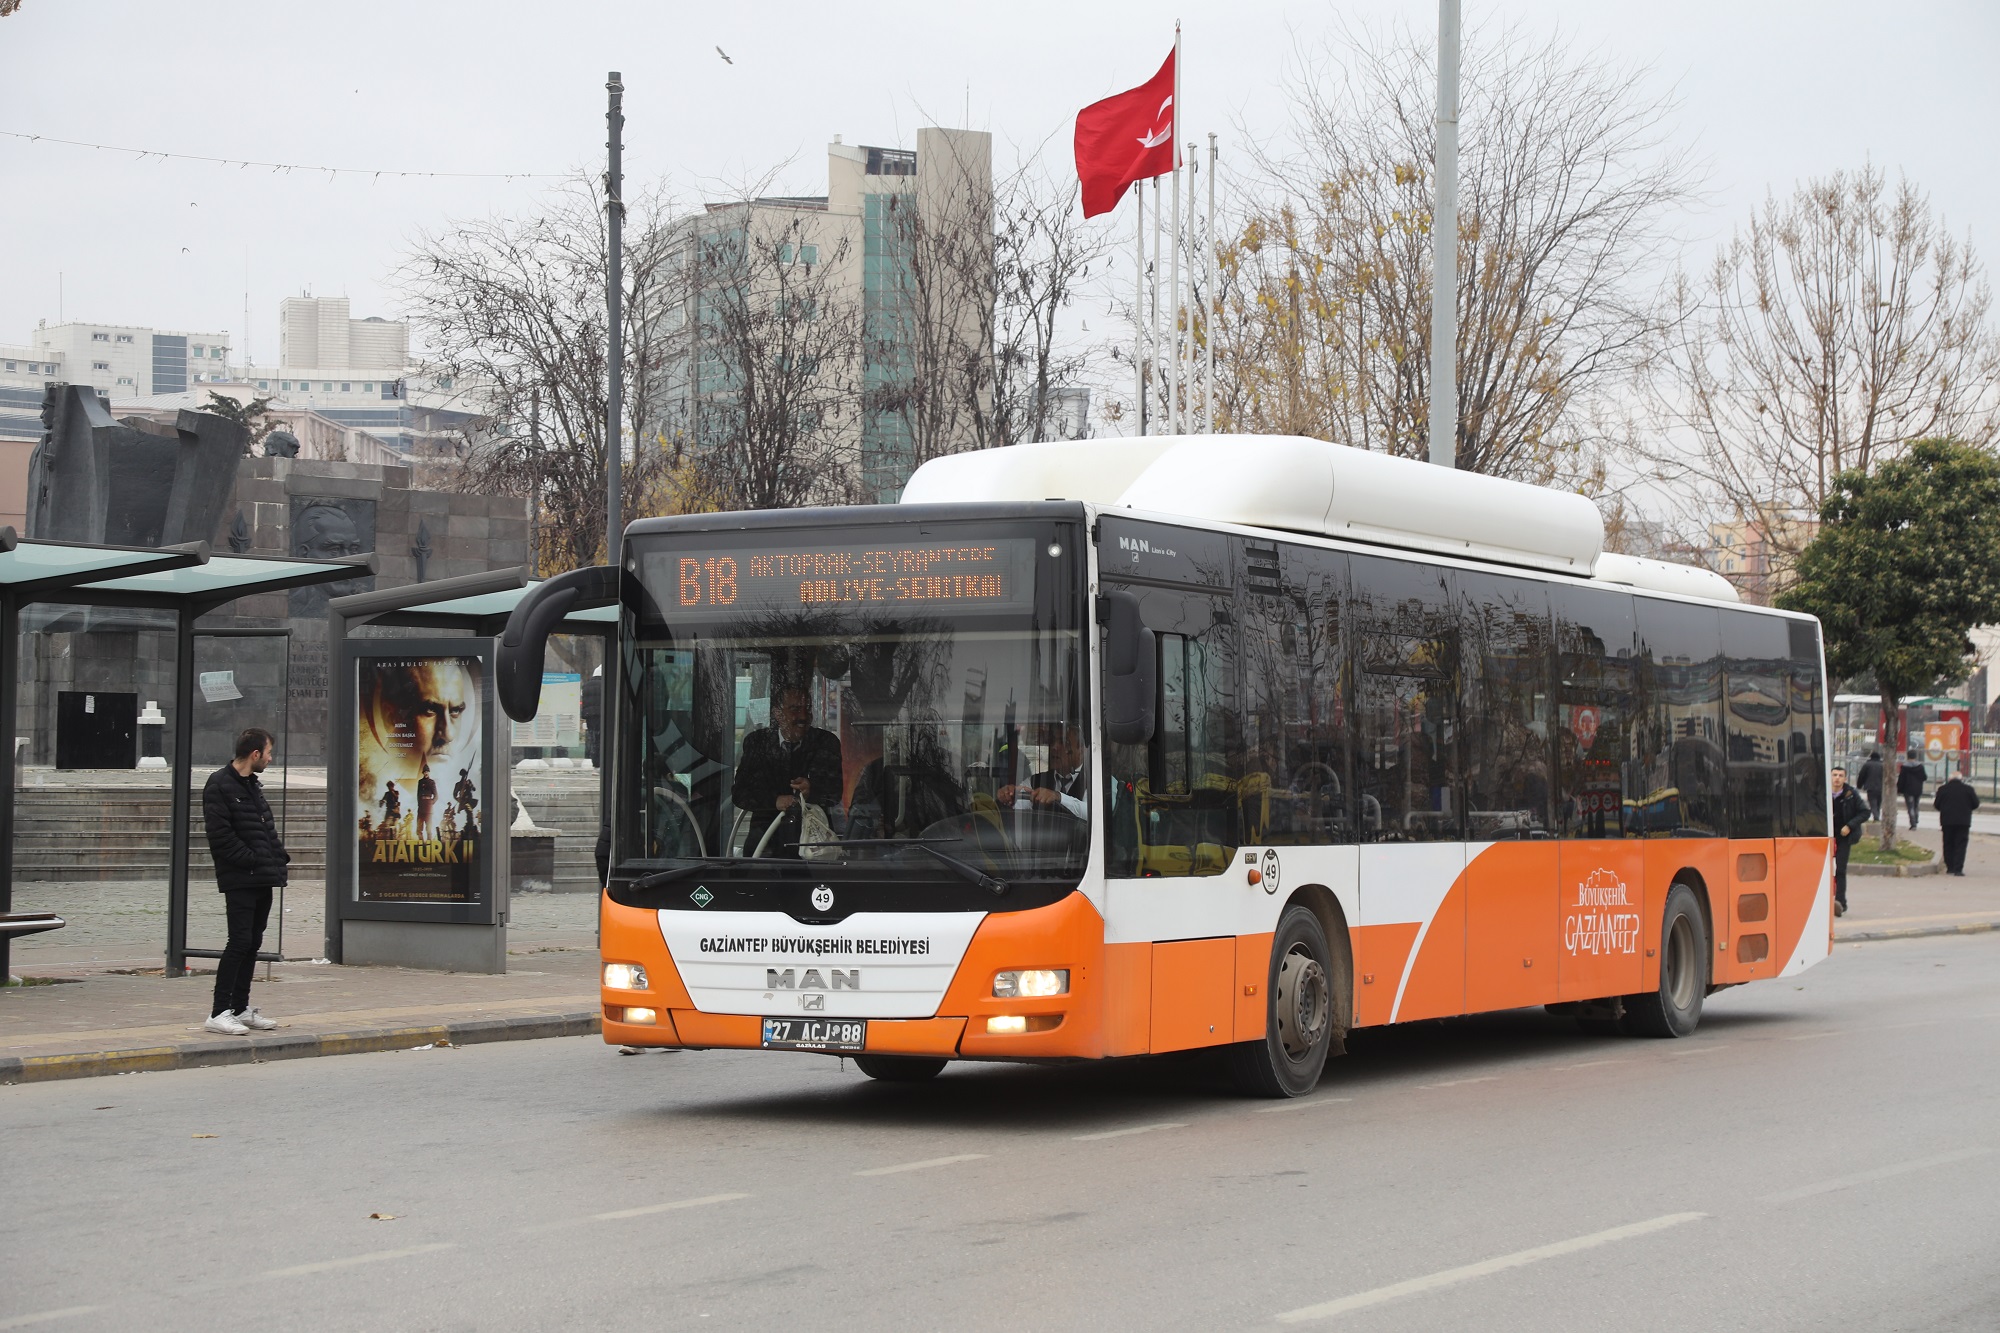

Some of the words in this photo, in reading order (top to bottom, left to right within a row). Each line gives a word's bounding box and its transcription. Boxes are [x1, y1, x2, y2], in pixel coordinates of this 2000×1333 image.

[1119, 536, 1149, 553] MAN
[1151, 547, 1165, 555] Lion's
[1166, 549, 1177, 558] City
[680, 556, 737, 606] B18
[372, 840, 459, 863] ATATÜRK
[463, 840, 474, 863] II
[1265, 864, 1277, 880] 49
[694, 893, 709, 901] CNG
[815, 893, 830, 903] 49
[1579, 882, 1627, 911] BÜYÜKŞEHİR
[1565, 908, 1640, 956] GAZİANTEP
[700, 935, 768, 953] GAZİANTEP
[772, 935, 852, 957] BÜYÜKŞEHİR
[856, 936, 930, 955] BELEDİYESİ
[766, 968, 860, 990] MAN
[772, 1022, 792, 1041] 27
[801, 1022, 831, 1042] ACJ
[841, 1023, 861, 1043] 88
